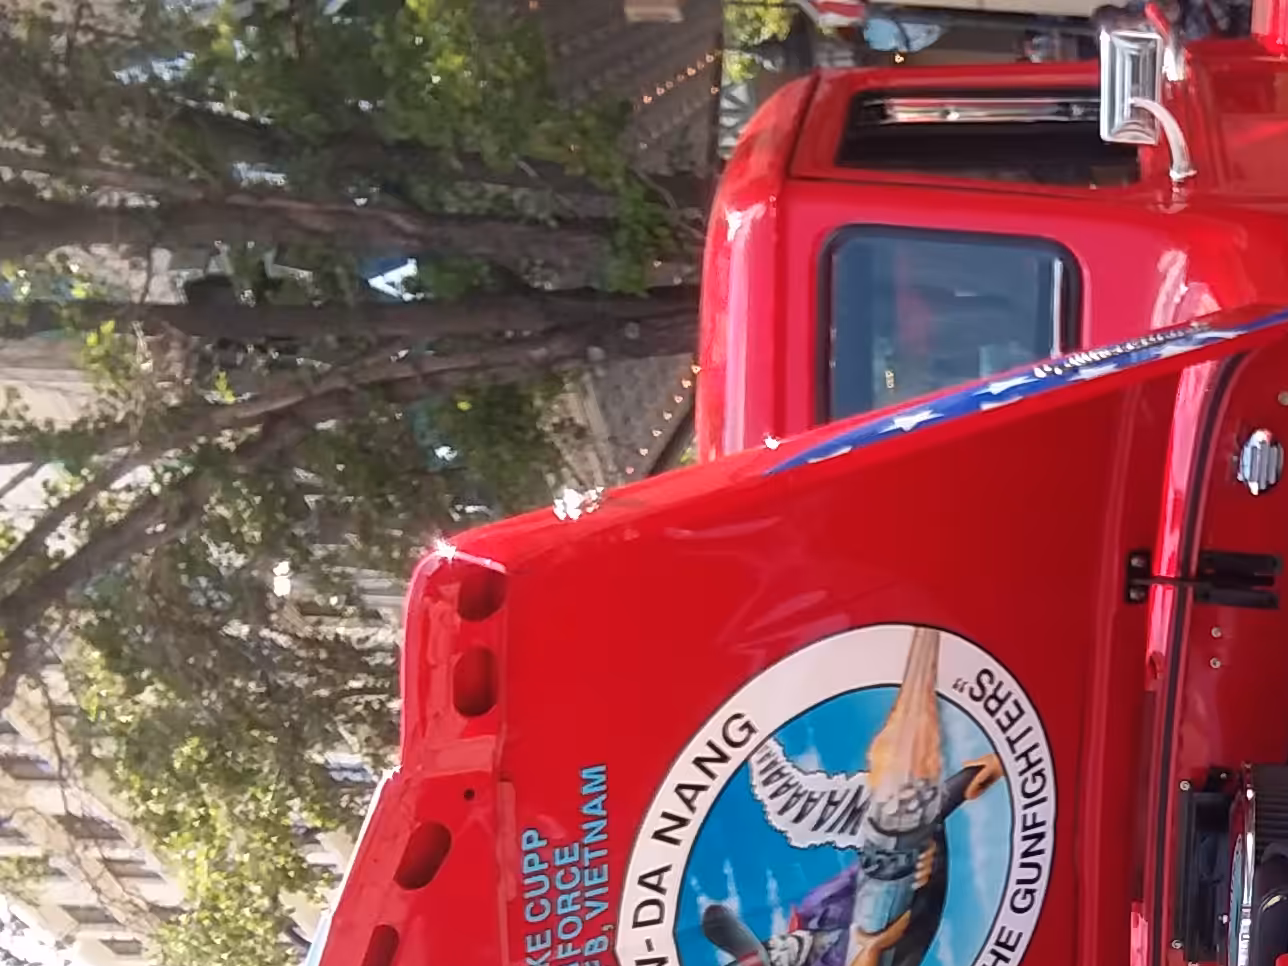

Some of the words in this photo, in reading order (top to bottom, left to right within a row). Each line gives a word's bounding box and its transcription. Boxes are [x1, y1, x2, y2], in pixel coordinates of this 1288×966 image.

[579, 763, 610, 921] VIETNAM
[650, 712, 759, 847] NANG
[520, 827, 552, 924] CUPP
